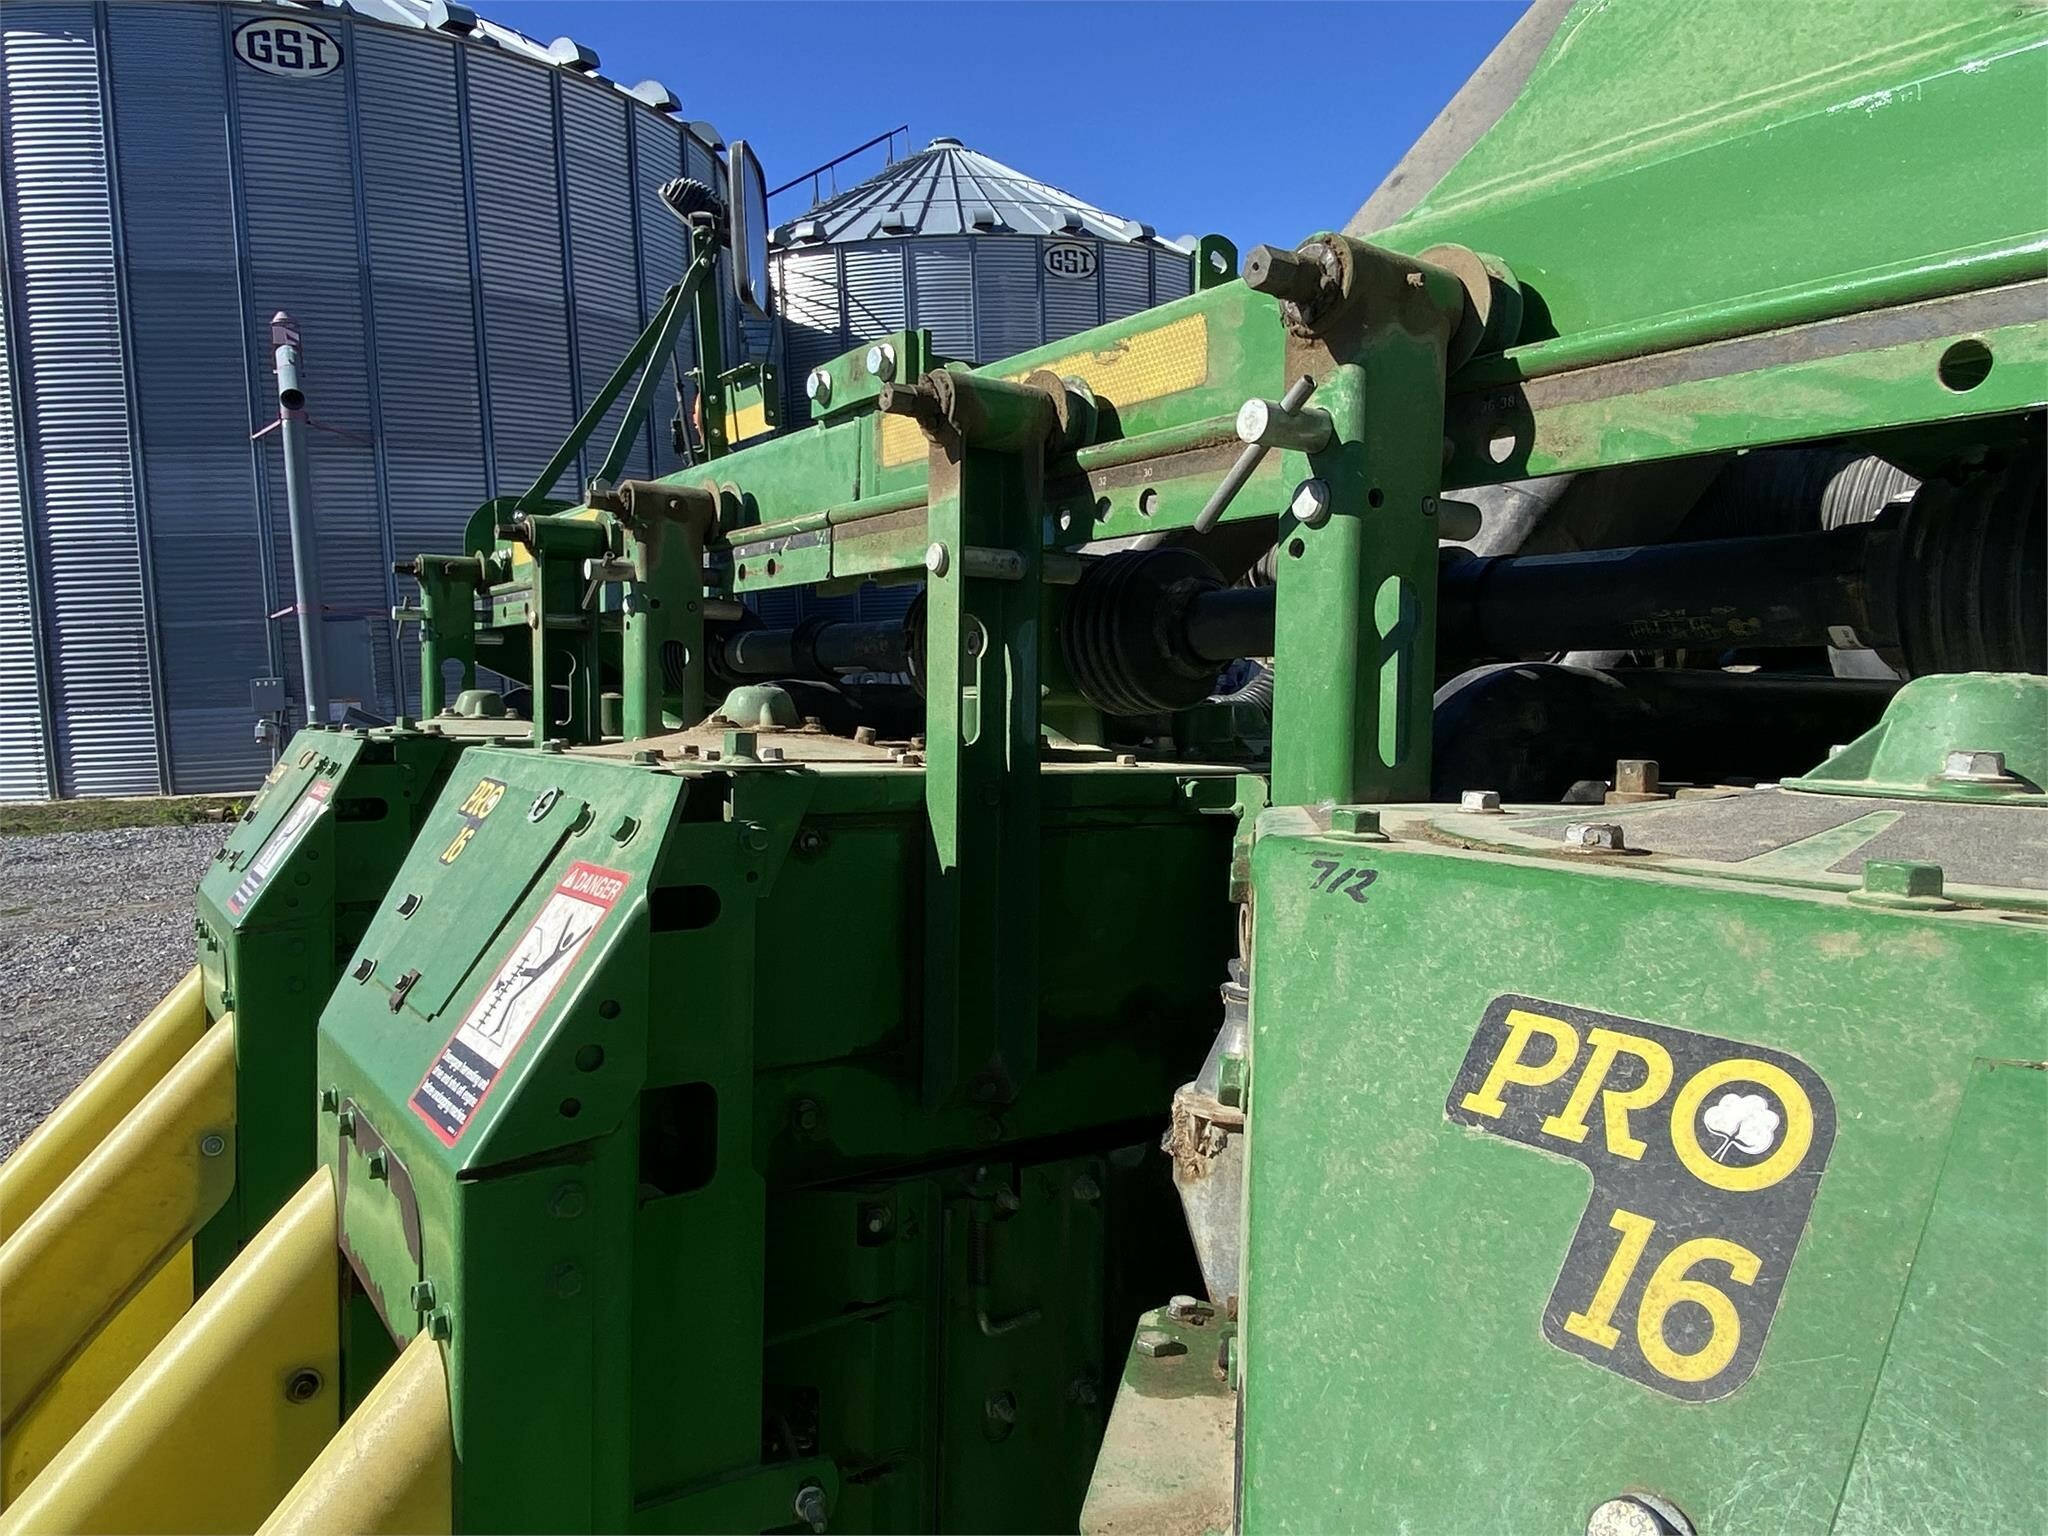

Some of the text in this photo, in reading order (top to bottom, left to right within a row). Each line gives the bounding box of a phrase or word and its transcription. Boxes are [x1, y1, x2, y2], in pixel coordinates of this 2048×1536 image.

[246, 28, 329, 69] GSI
[1050, 249, 1091, 273] GSI
[459, 780, 506, 819] PRO
[441, 826, 476, 863] 16
[573, 871, 623, 902] DANGER
[1460, 1009, 1815, 1192] PRO
[1563, 1208, 1763, 1382] 16
